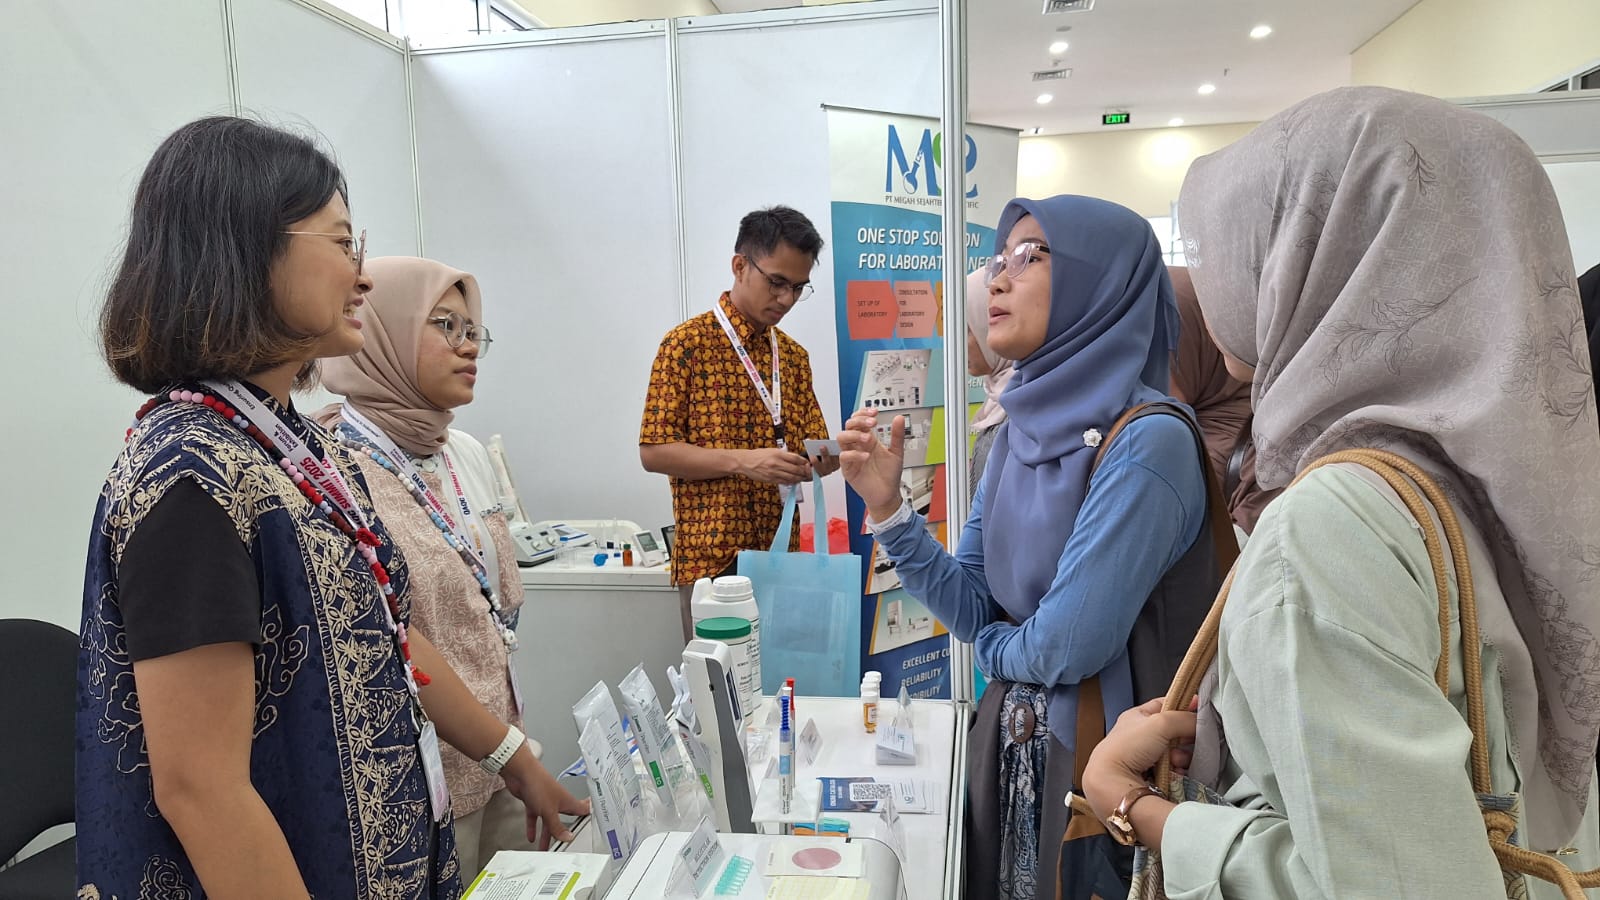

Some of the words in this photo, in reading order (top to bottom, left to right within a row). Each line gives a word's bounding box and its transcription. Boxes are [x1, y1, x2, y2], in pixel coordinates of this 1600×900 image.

[1106, 115, 1127, 123] EXIT
[894, 196, 916, 205] MEGAH
[916, 198, 943, 207] SEJAHTE
[857, 227, 886, 244] ONE
[888, 228, 920, 245] STOP
[858, 253, 887, 269] FOR
[889, 254, 944, 270] LABORAT
[233, 388, 256, 410] Ensuring
[275, 423, 299, 449] Exhibition
[278, 436, 294, 451] Forum
[300, 456, 324, 480] 2025
[319, 479, 351, 511] SUMMIT
[411, 472, 427, 492] QAQC
[424, 490, 444, 514] SUMMIT
[459, 497, 471, 516] QAQC
[902, 650, 940, 670] EXCELLENT
[901, 667, 942, 687] RELIABILITY
